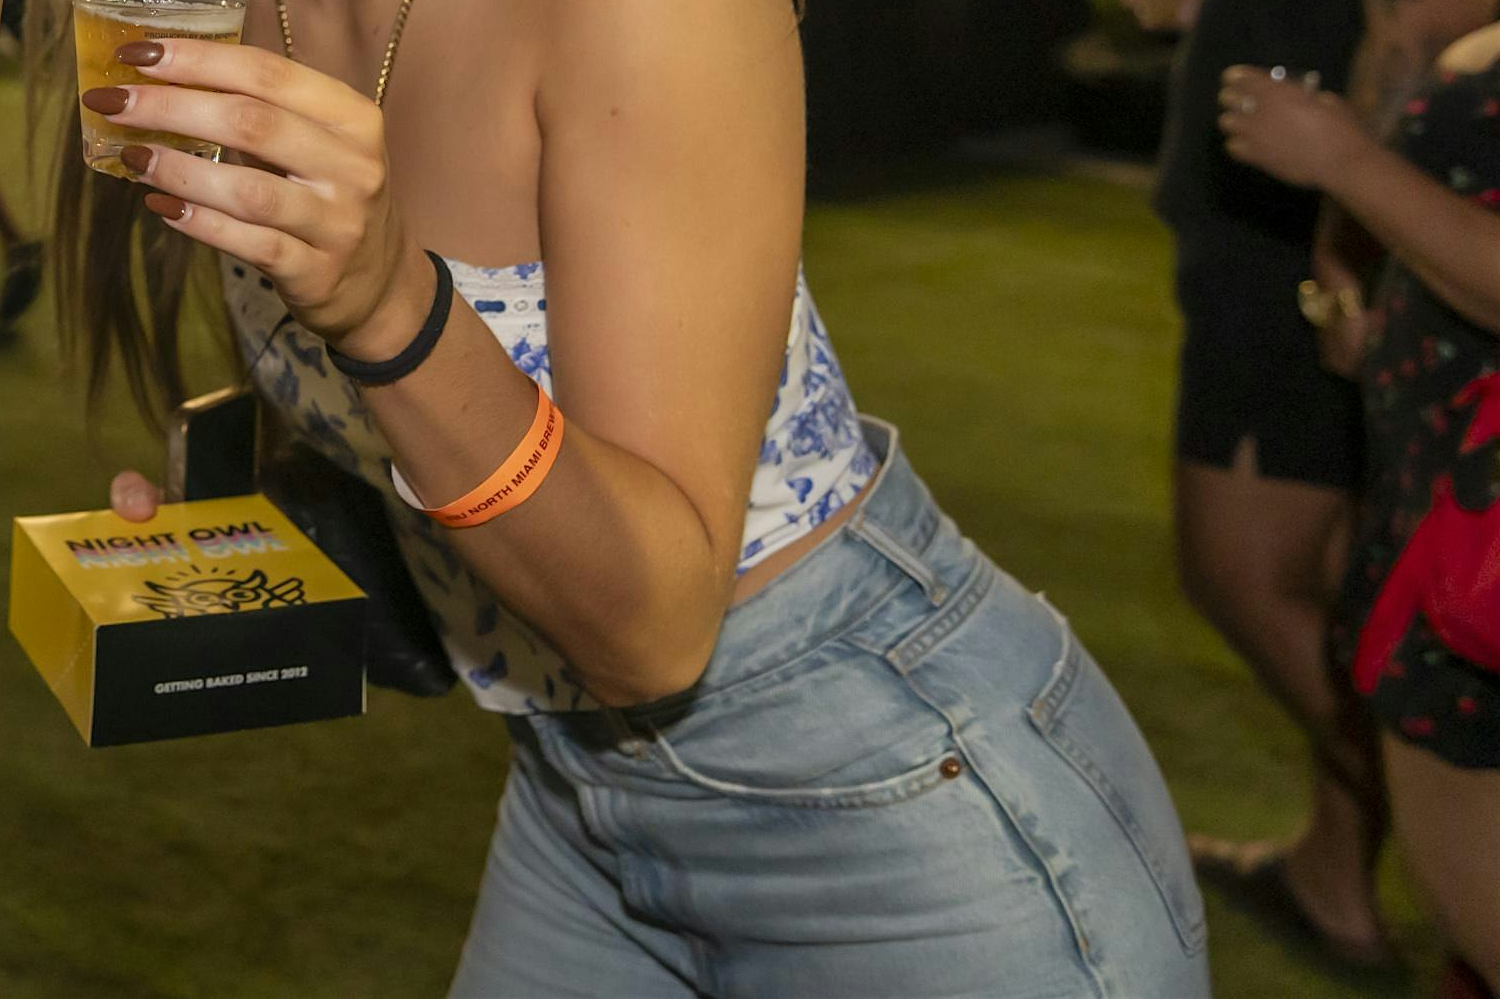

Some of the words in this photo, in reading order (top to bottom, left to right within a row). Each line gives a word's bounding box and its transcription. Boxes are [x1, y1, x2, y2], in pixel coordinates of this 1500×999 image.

[467, 485, 513, 515] NORTH
[511, 449, 542, 487] MIAMI
[65, 532, 179, 553] NIGHT
[188, 521, 273, 542] OWL
[154, 678, 204, 694] GETTING
[205, 674, 245, 689] BAKED
[246, 670, 279, 684] SINCE
[280, 666, 308, 680] 2012
